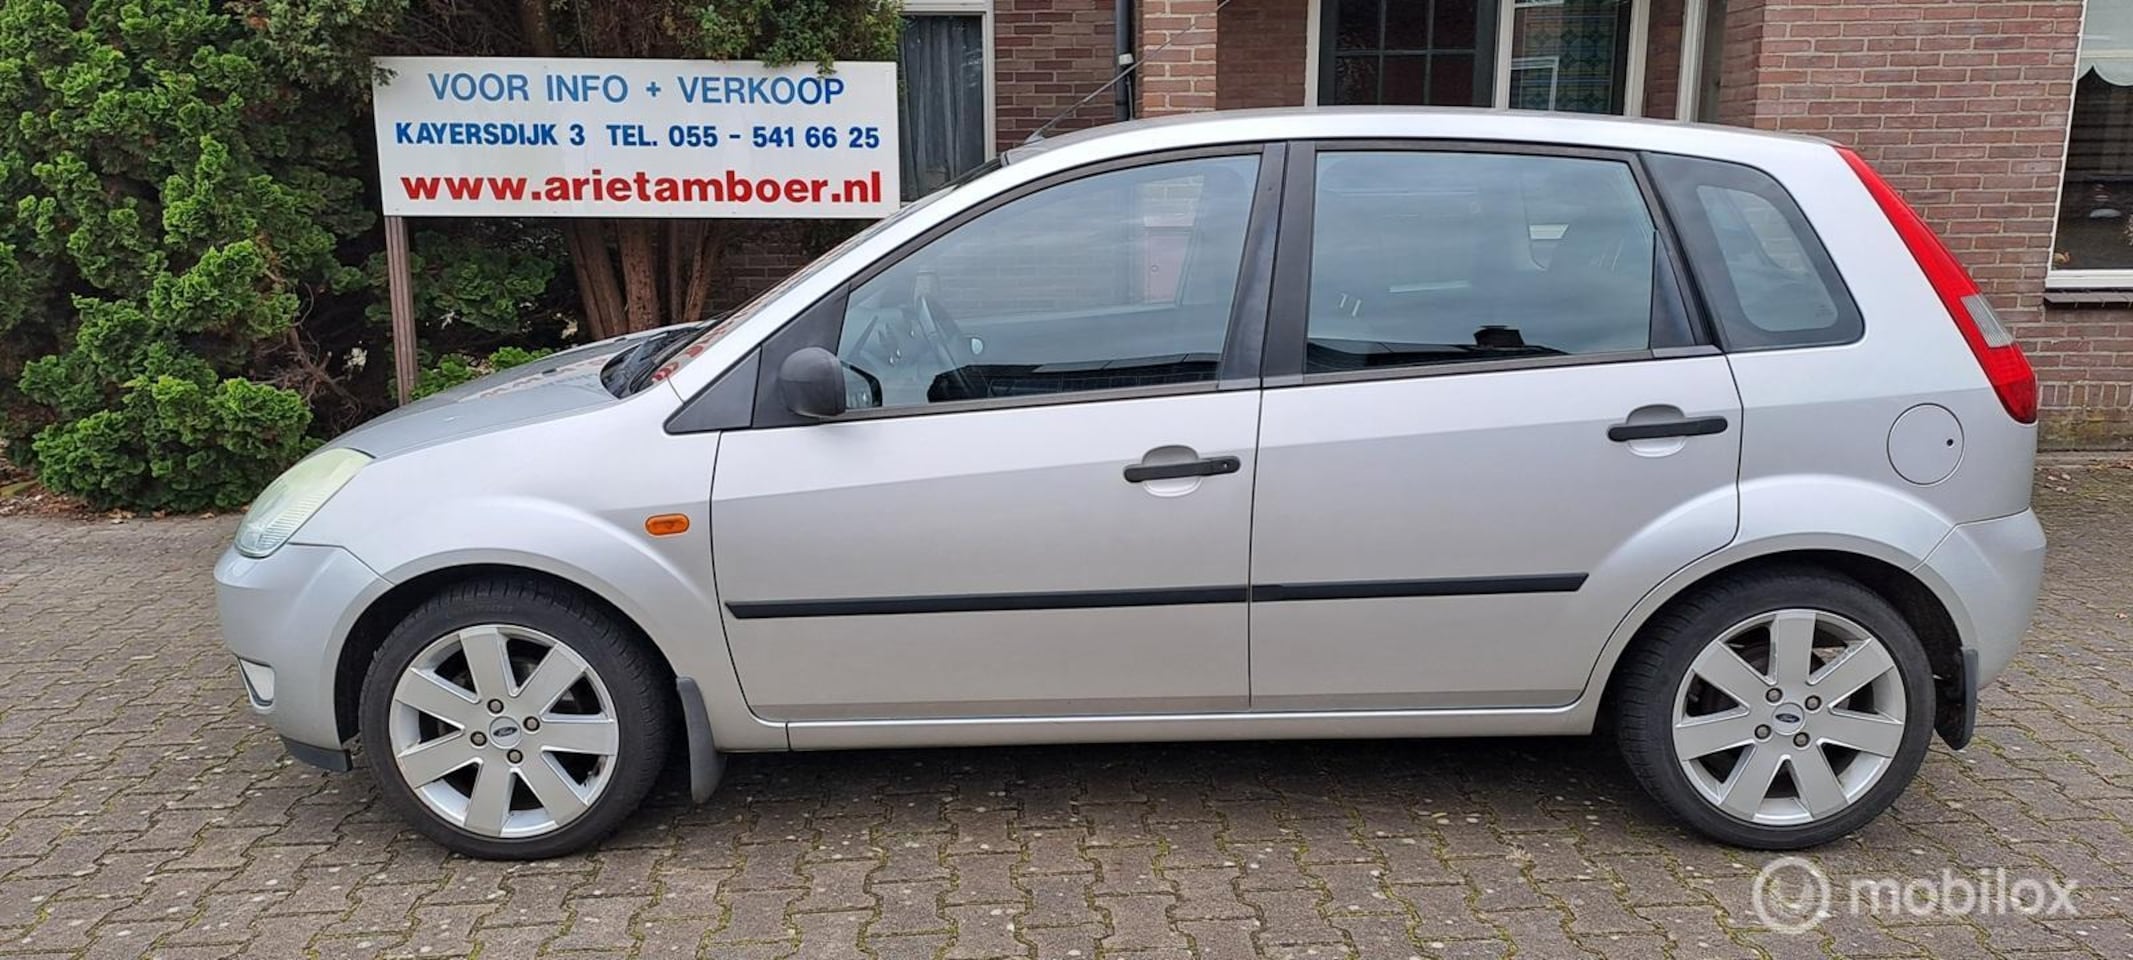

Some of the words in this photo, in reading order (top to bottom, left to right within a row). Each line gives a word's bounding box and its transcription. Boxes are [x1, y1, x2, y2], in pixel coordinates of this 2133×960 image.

[428, 73, 530, 103] VOOR
[545, 74, 629, 104] INFO
[646, 82, 661, 97] +
[678, 75, 846, 106] VERKOOP
[394, 121, 558, 146] KAYERSDIJK
[569, 122, 587, 146] 3
[605, 122, 659, 148] TEL.
[668, 124, 720, 148] 055
[751, 125, 797, 149] 541
[803, 125, 839, 149] 66
[848, 126, 881, 149] 25
[401, 169, 883, 204] www.arietamboer.nl
